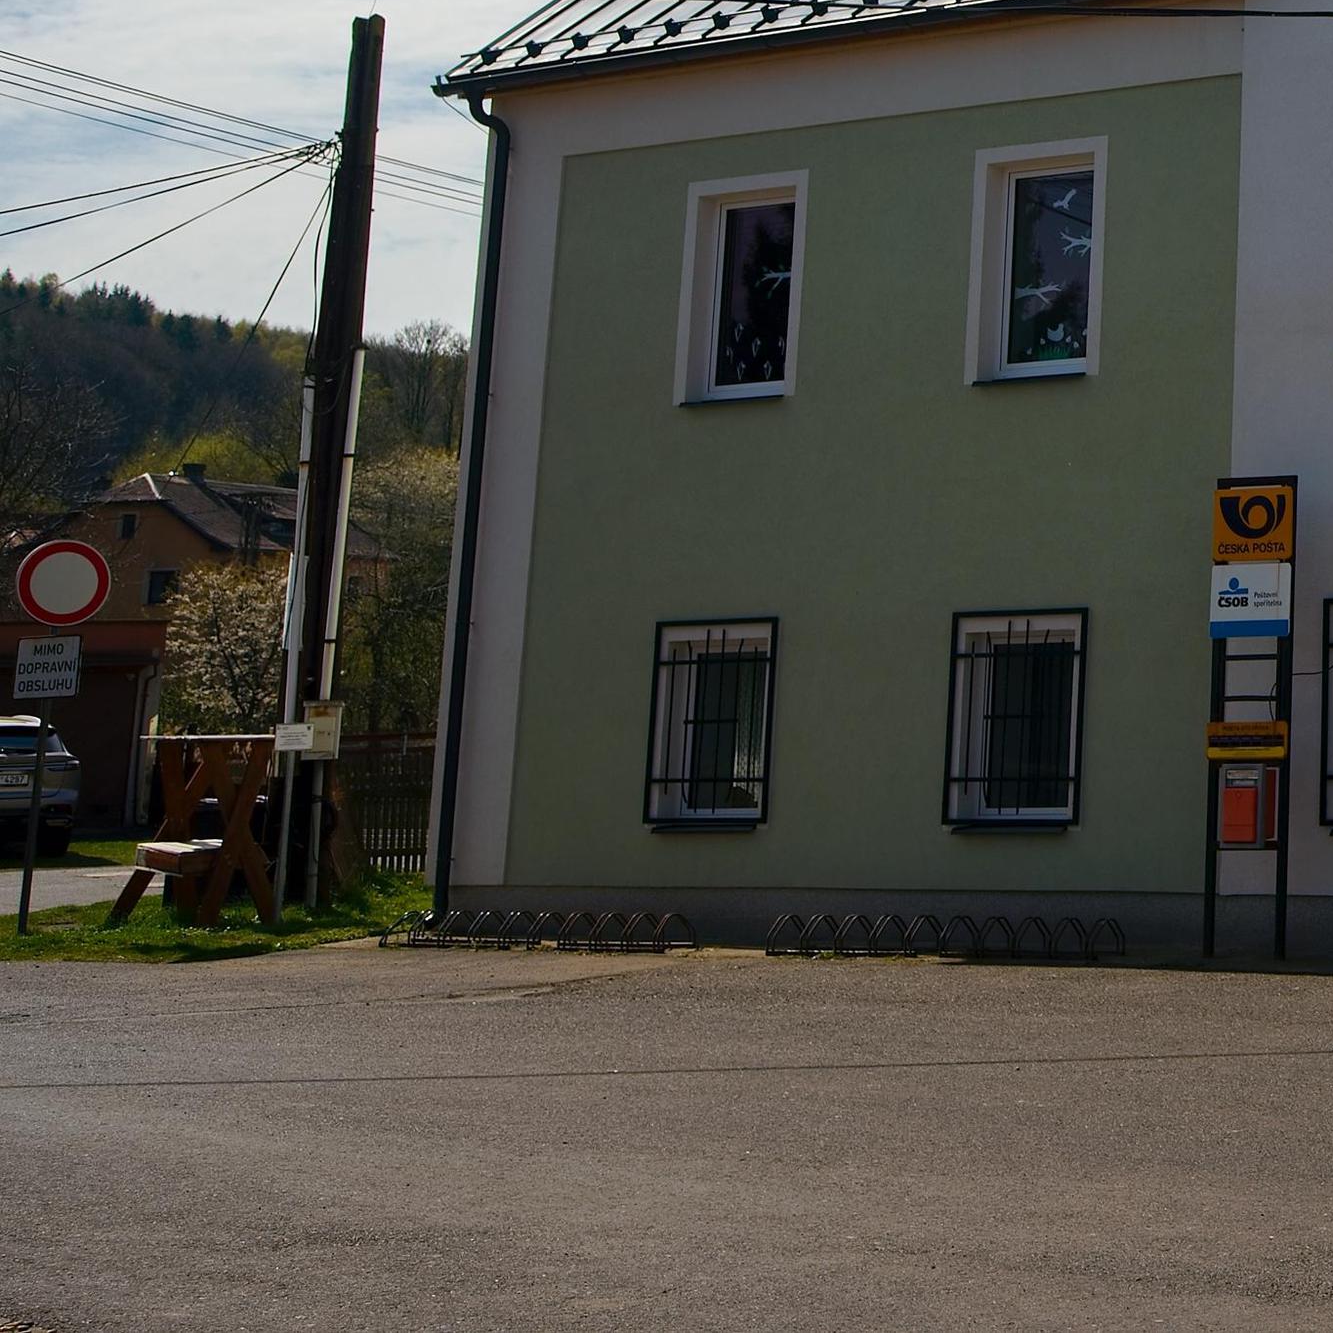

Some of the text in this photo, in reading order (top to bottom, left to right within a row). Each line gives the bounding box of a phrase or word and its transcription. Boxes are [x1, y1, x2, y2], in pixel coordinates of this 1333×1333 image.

[1252, 541, 1285, 553] POŠTA
[1218, 596, 1249, 607] ČSOB
[33, 643, 64, 656] MIMO
[18, 658, 77, 675] DOPRAVNÍ
[18, 678, 73, 692] OBSLUHU
